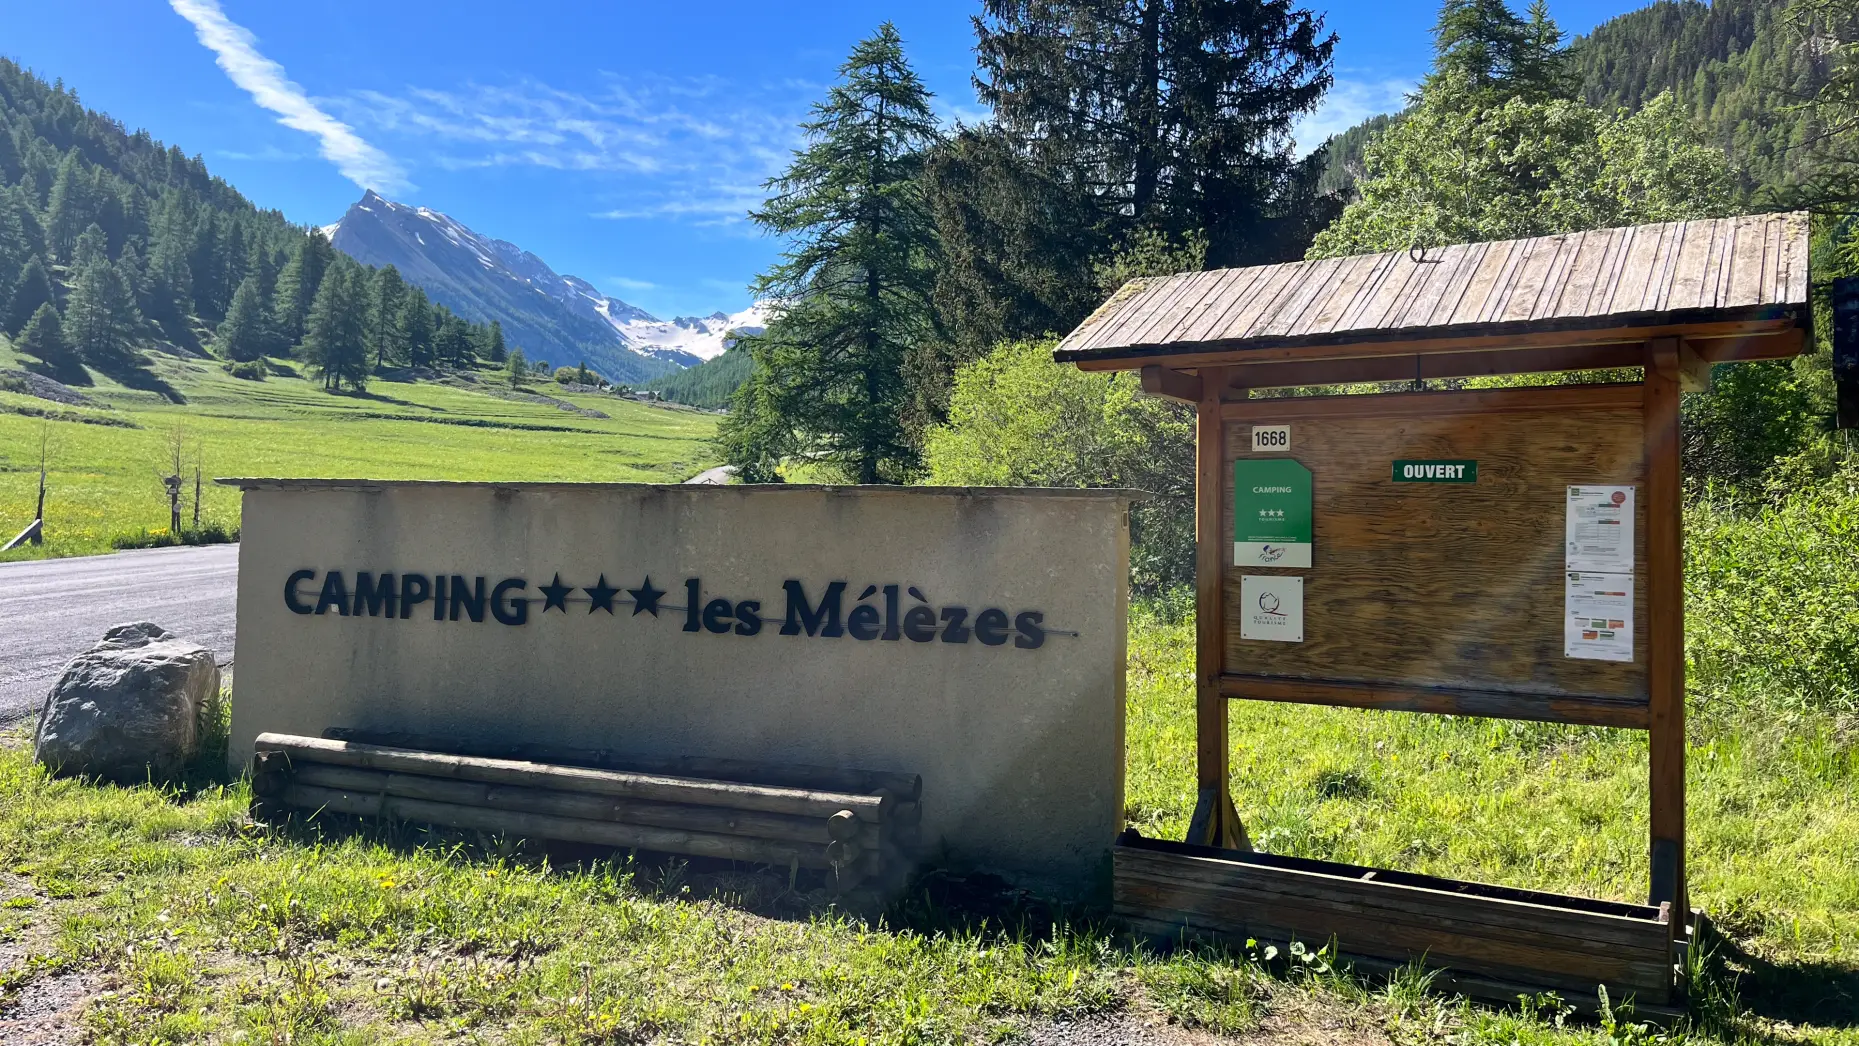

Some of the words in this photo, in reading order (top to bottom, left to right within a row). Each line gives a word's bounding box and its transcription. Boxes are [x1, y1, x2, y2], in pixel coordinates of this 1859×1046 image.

[1255, 430, 1287, 446] 1668
[1403, 464, 1466, 479] OUVERT
[1252, 486, 1292, 494] CAMPING
[284, 569, 527, 625] CAMPING
[682, 578, 762, 636] les
[778, 579, 1045, 649] Mélèzes
